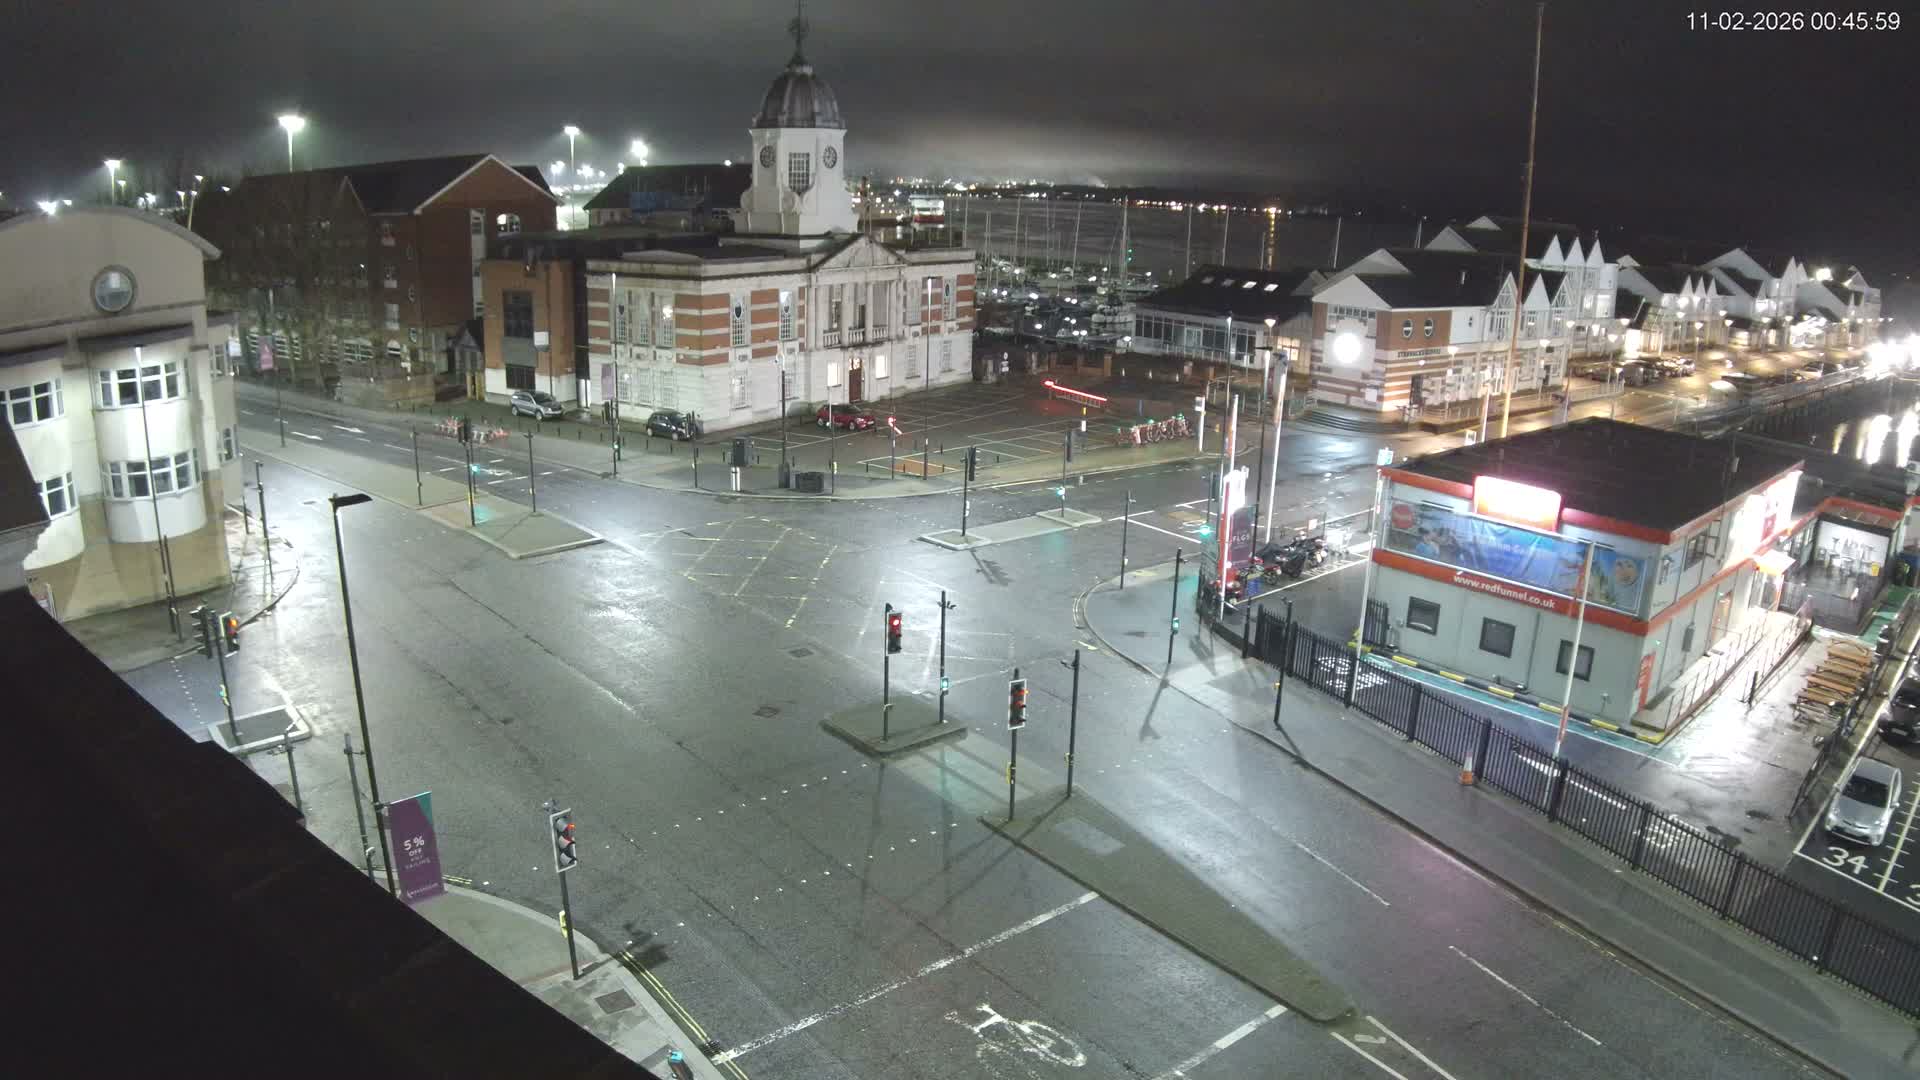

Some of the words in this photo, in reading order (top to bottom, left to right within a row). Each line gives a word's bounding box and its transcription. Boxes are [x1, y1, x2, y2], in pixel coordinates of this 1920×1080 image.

[1453, 575, 1556, 609] www.redfunnel.co.uk
[408, 848, 422, 857] OFF
[1823, 846, 1869, 875] 34
